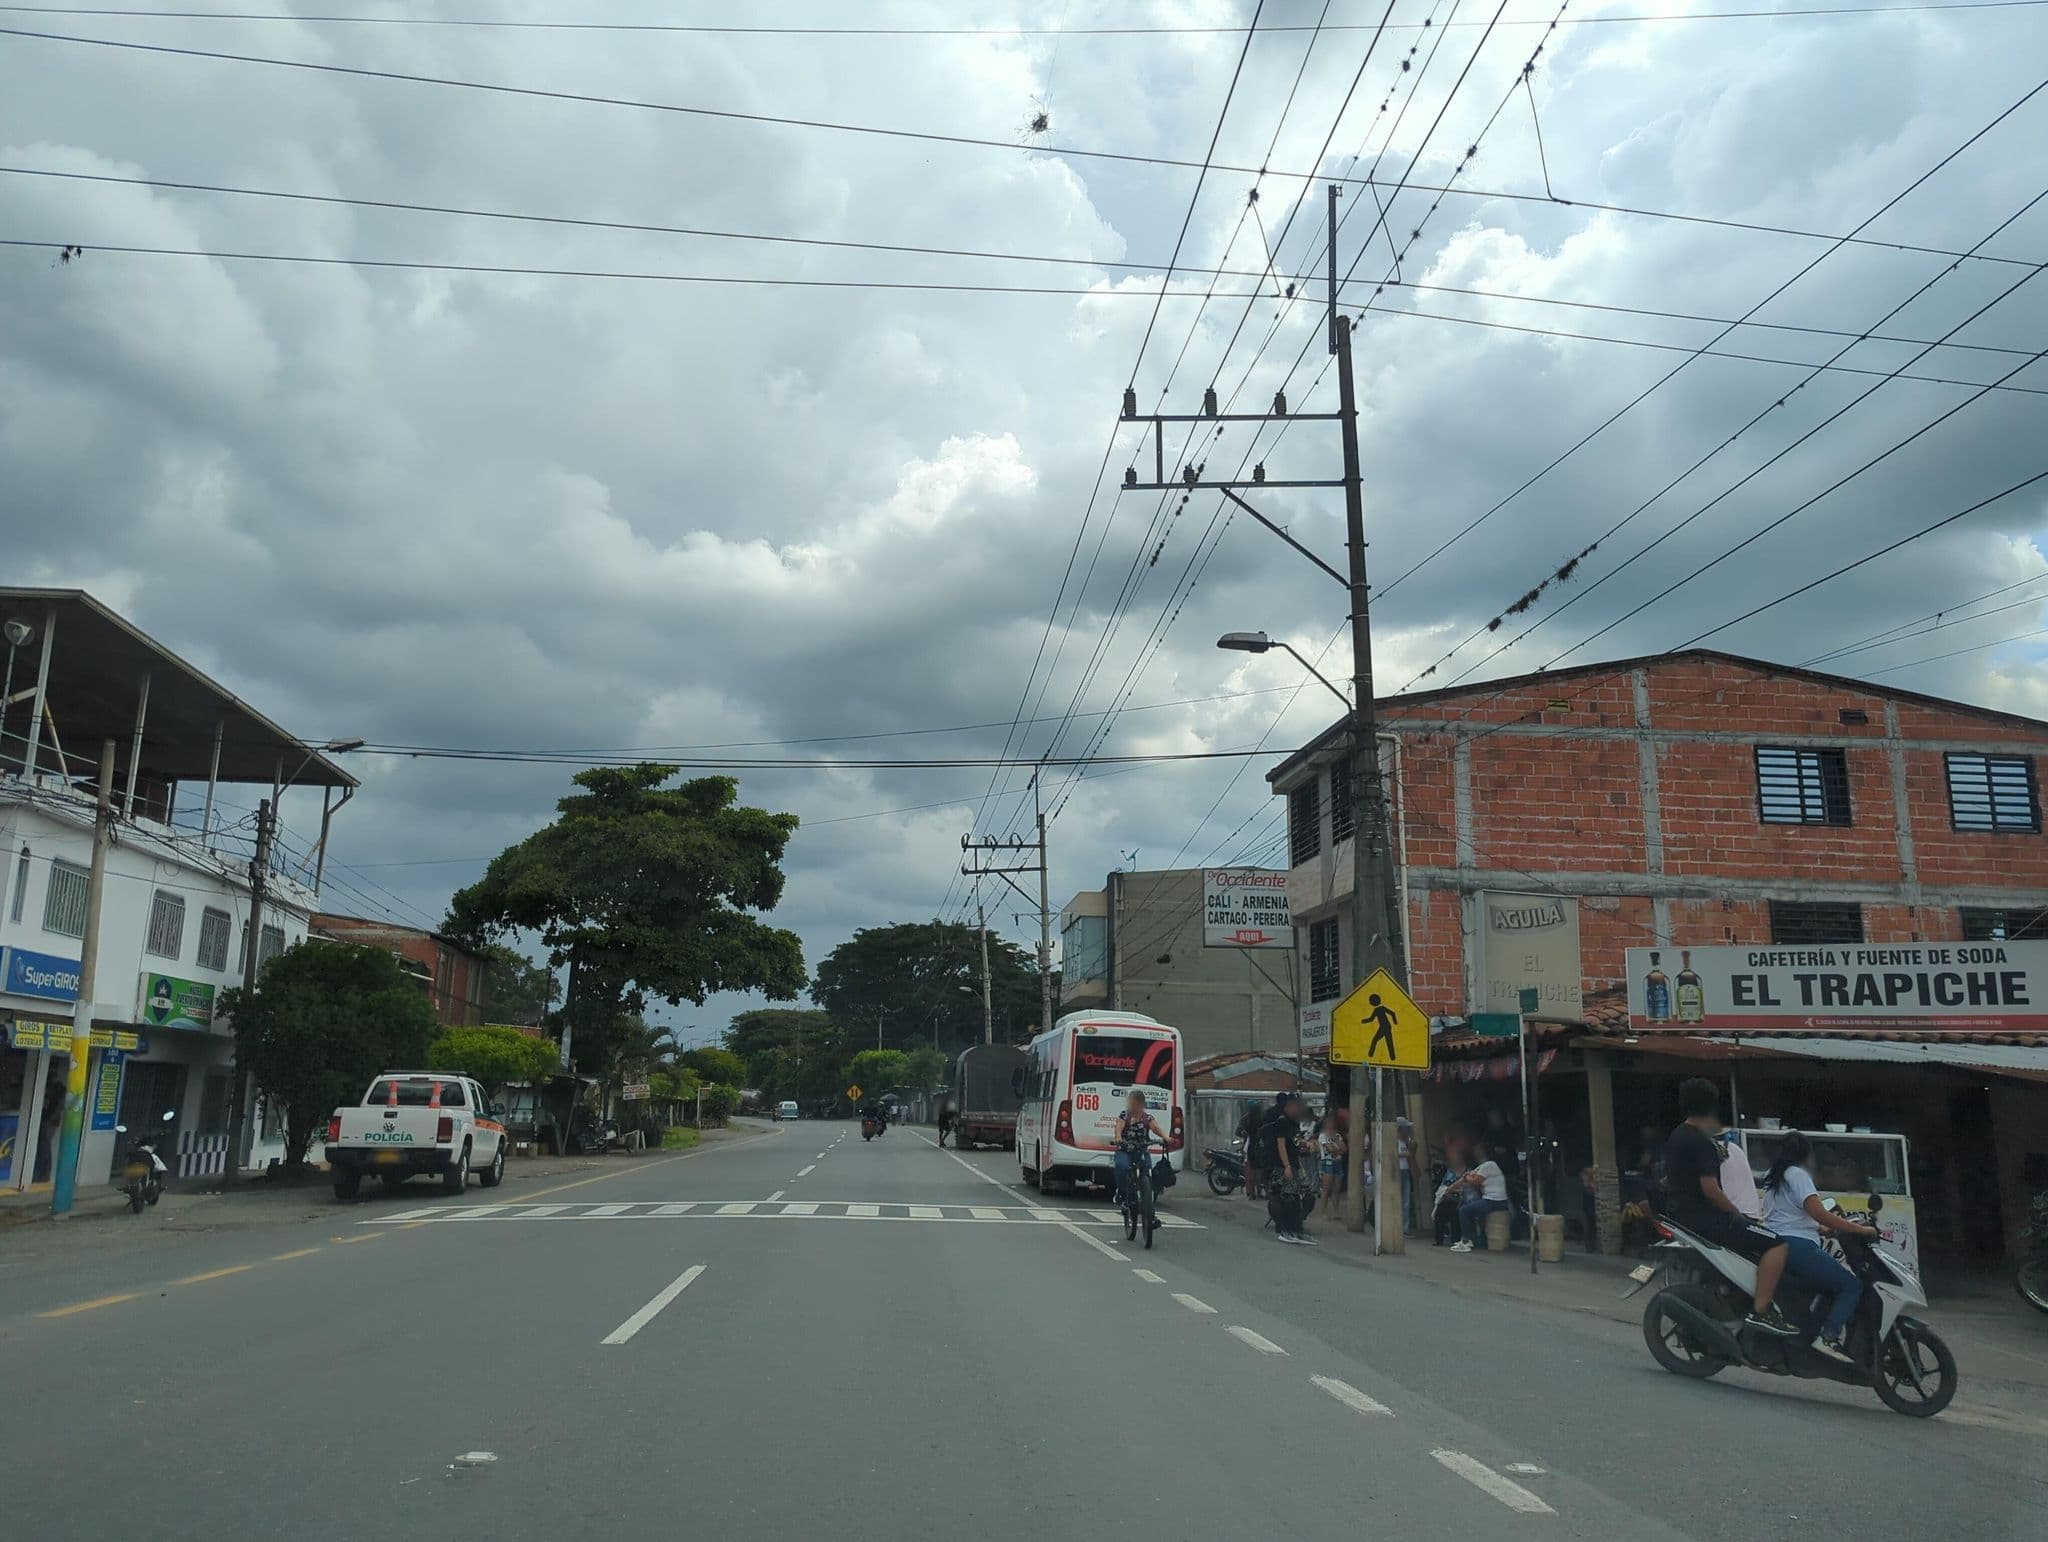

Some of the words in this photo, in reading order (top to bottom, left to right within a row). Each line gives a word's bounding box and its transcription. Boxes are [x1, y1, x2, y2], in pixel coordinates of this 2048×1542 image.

[1216, 872, 1286, 888] Occidente
[1208, 895, 1231, 908] CALI
[1242, 896, 1289, 909] ARMENIA
[1208, 912, 1247, 925] CARTAGO
[1253, 913, 1290, 926] PEREIRA
[1495, 905, 1565, 929] AGUILA
[1524, 954, 1544, 972] EL
[1747, 948, 1836, 968] CAFETERÍA
[1840, 951, 1851, 966] Y
[1857, 950, 1923, 966] FUENTE
[1929, 949, 1951, 965] DE
[1957, 947, 2007, 964] SODA
[1488, 981, 1579, 1003] TRAICHE
[1731, 974, 1781, 1006] EL
[1793, 971, 2031, 1006] TRAPICHE
[1076, 1094, 1100, 1111] 058
[364, 1131, 414, 1143] POLICÍA
